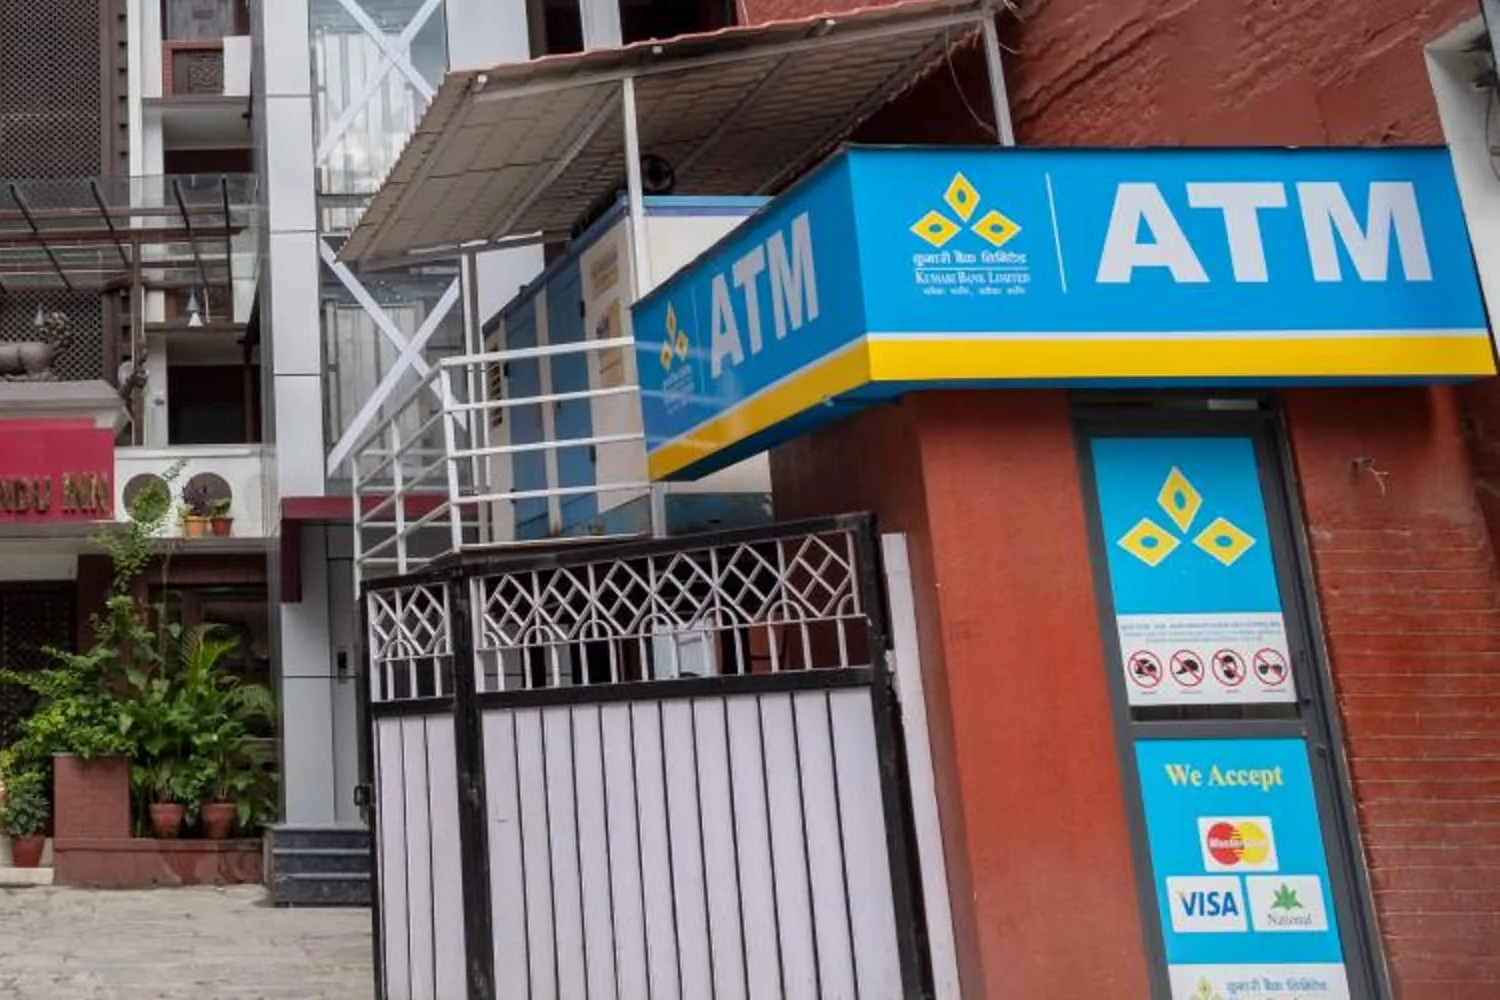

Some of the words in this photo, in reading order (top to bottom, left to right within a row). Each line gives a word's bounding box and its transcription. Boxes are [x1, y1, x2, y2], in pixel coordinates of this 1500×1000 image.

[1096, 181, 1433, 283] ATM
[710, 211, 819, 380] ATM
[957, 271, 986, 284] BANK
[61, 470, 111, 515] INN
[1164, 763, 1202, 787] We
[1207, 763, 1283, 792] Accept
[1179, 891, 1239, 917] VISA
